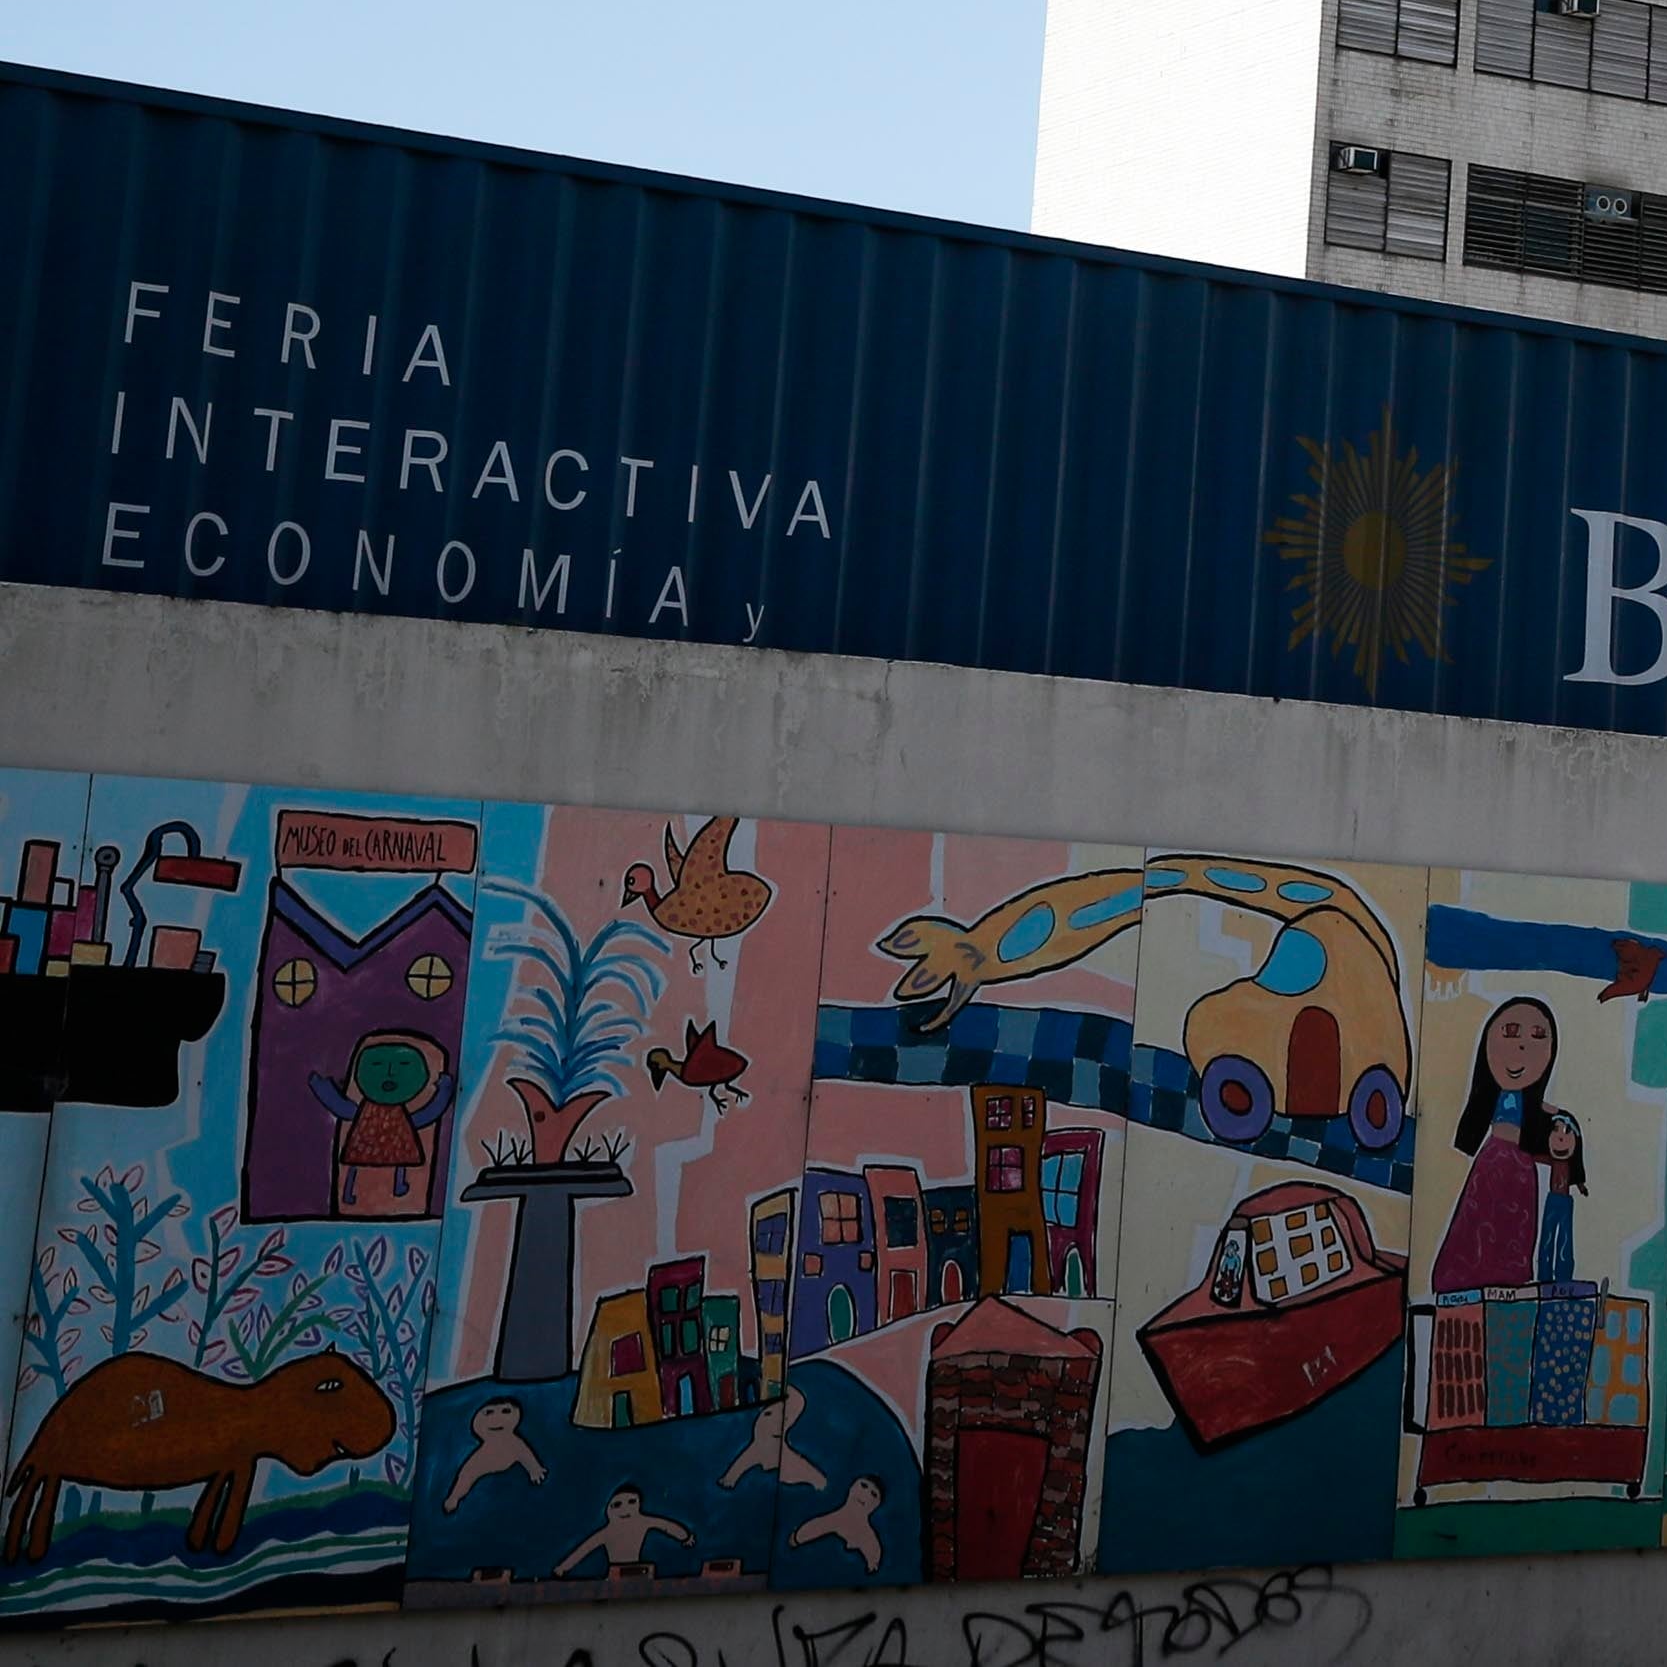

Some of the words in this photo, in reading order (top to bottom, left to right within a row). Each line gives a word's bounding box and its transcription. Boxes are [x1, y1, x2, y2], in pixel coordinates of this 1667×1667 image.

[125, 280, 450, 388] FERIA
[110, 390, 831, 540] INTERACTIVA
[102, 501, 690, 628] ECONOMÍA
[742, 601, 766, 644] y
[282, 824, 336, 857] MUSEO
[342, 837, 362, 858] DEL
[364, 829, 447, 864] CARNAVAL
[1487, 1289, 1516, 1302] MAM
